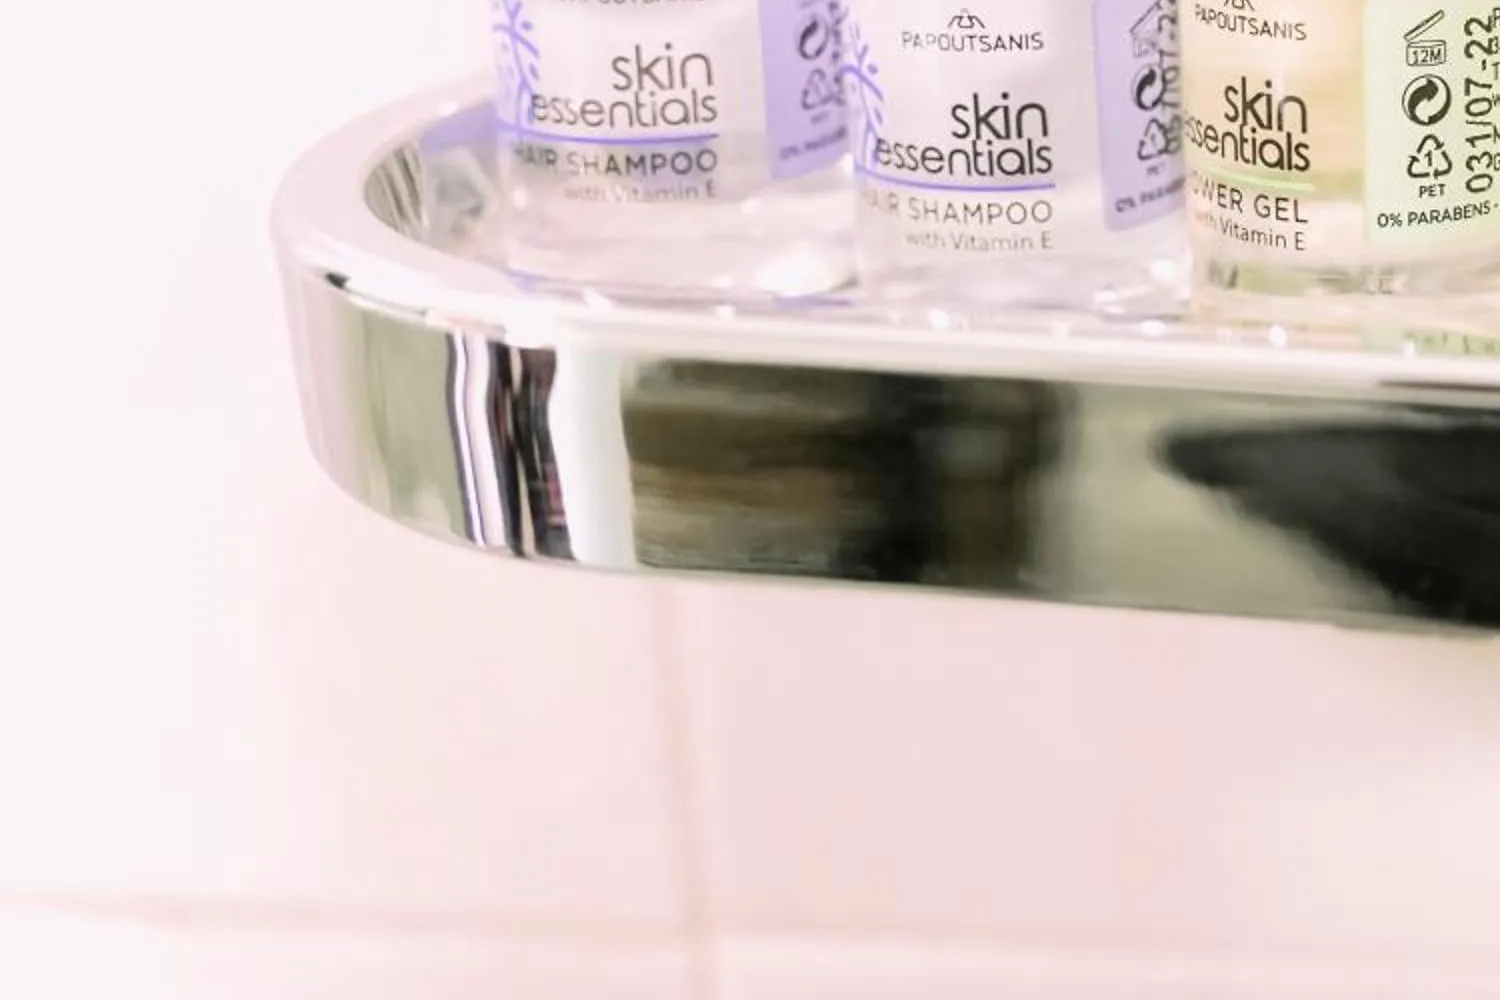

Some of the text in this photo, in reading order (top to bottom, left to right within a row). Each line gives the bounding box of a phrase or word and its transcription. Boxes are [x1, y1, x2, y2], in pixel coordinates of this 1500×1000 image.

[1194, 2, 1308, 42] PAPOUTSANIS
[901, 30, 1045, 53] PAPOUTSANIS
[1411, 48, 1443, 64] 12M
[611, 42, 714, 91] skin
[529, 88, 718, 129] essentials
[950, 91, 1049, 140] skin
[1223, 75, 1308, 134] skin
[566, 148, 718, 178] SHAMPOO
[874, 136, 1054, 177] essentials
[705, 177, 717, 200] E
[1418, 183, 1447, 199] PET
[908, 197, 1053, 226] SHAMPOO
[1252, 192, 1310, 225] GEL
[1376, 212, 1403, 229] 0%
[1406, 200, 1491, 227] PARABENS
[906, 228, 1054, 252] with Vitamin E
[1219, 216, 1288, 250] Vitamin
[1294, 230, 1307, 252] E
